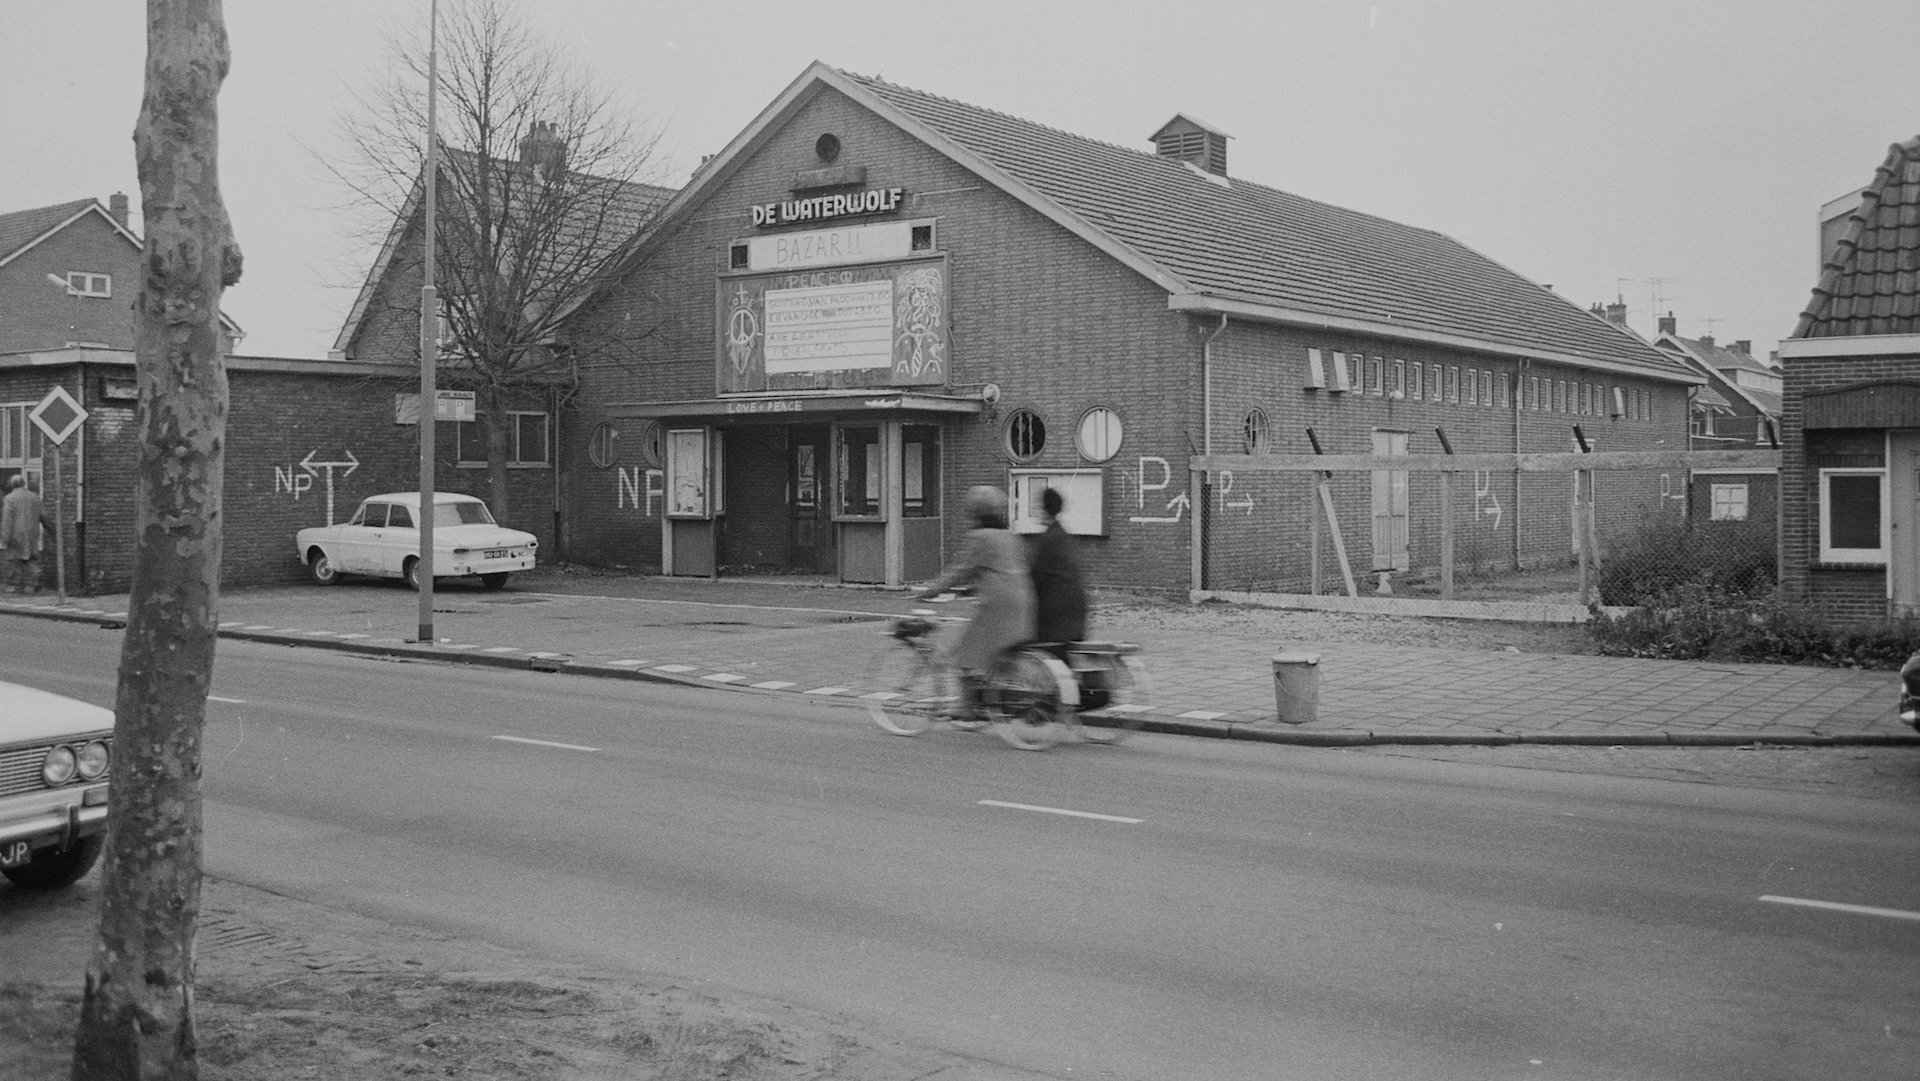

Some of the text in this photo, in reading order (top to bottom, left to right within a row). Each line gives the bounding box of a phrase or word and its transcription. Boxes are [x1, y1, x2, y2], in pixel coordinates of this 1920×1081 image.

[752, 188, 902, 226] DE WATERWOLF
[728, 402, 757, 414] LOVE
[767, 401, 803, 412] PEACE
[275, 464, 312, 500] NP
[1220, 470, 1233, 514] P
[1660, 473, 1671, 509] P
